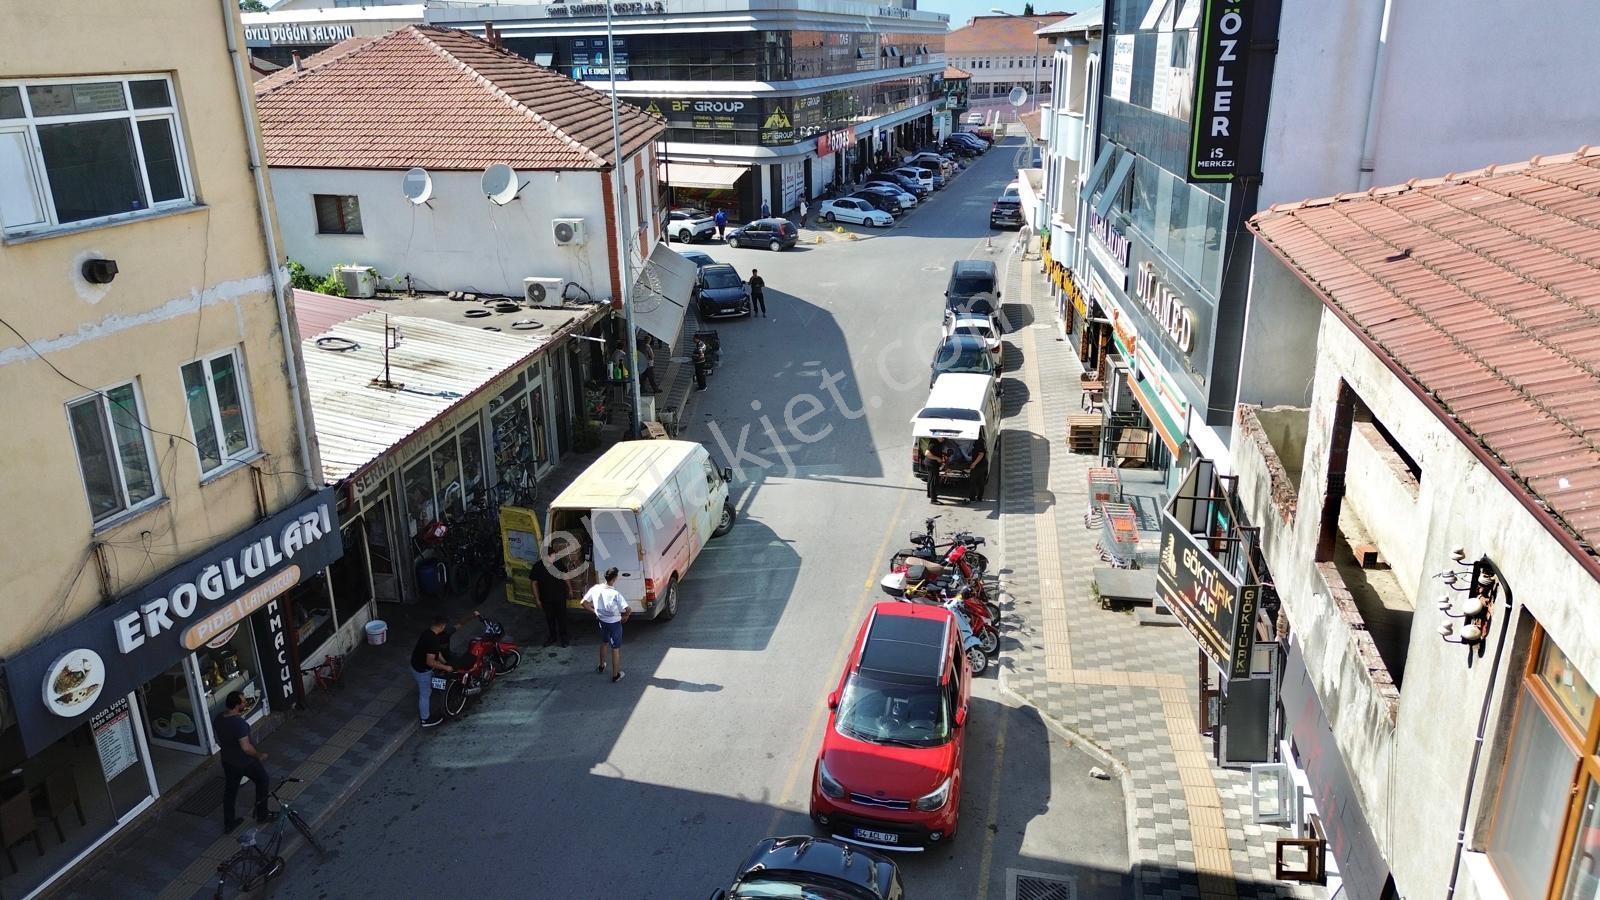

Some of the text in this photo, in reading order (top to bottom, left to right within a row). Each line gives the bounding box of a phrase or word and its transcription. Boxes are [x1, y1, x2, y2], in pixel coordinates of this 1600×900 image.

[245, 24, 353, 41] ÖYLÜ DÜĞÜN SALONU
[1211, 0, 1242, 137] ÖZLER
[672, 101, 744, 113] BF GROUP
[762, 132, 773, 140] BF
[774, 131, 794, 140] GROUP
[355, 453, 400, 494] SERHAT
[1183, 548, 1234, 614] GÖKTÜRK
[1193, 581, 1218, 621] YAPI
[1235, 590, 1254, 669] GÖKTÜRK
